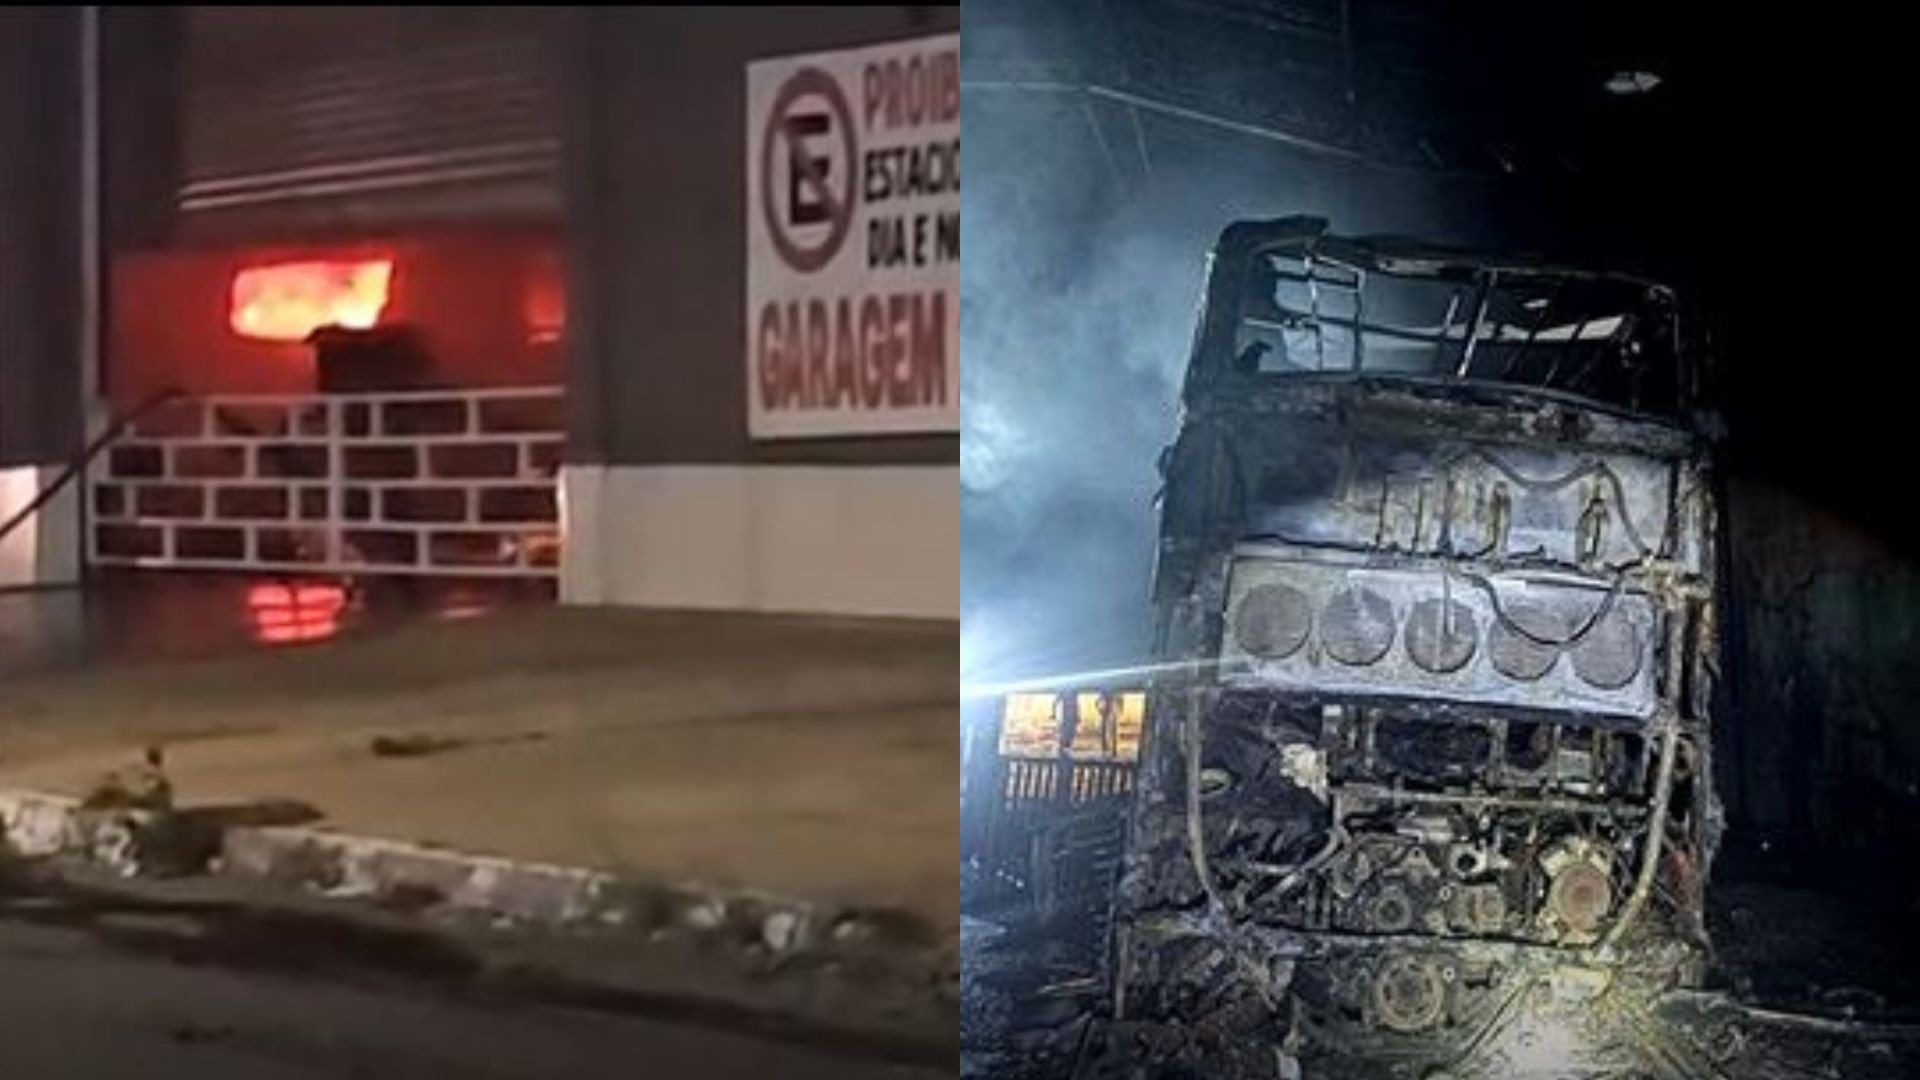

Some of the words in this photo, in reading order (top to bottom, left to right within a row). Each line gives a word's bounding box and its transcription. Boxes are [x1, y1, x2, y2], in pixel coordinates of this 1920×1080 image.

[869, 215, 908, 269] DIA
[914, 212, 930, 268] E
[759, 291, 947, 412] GARAGEM
